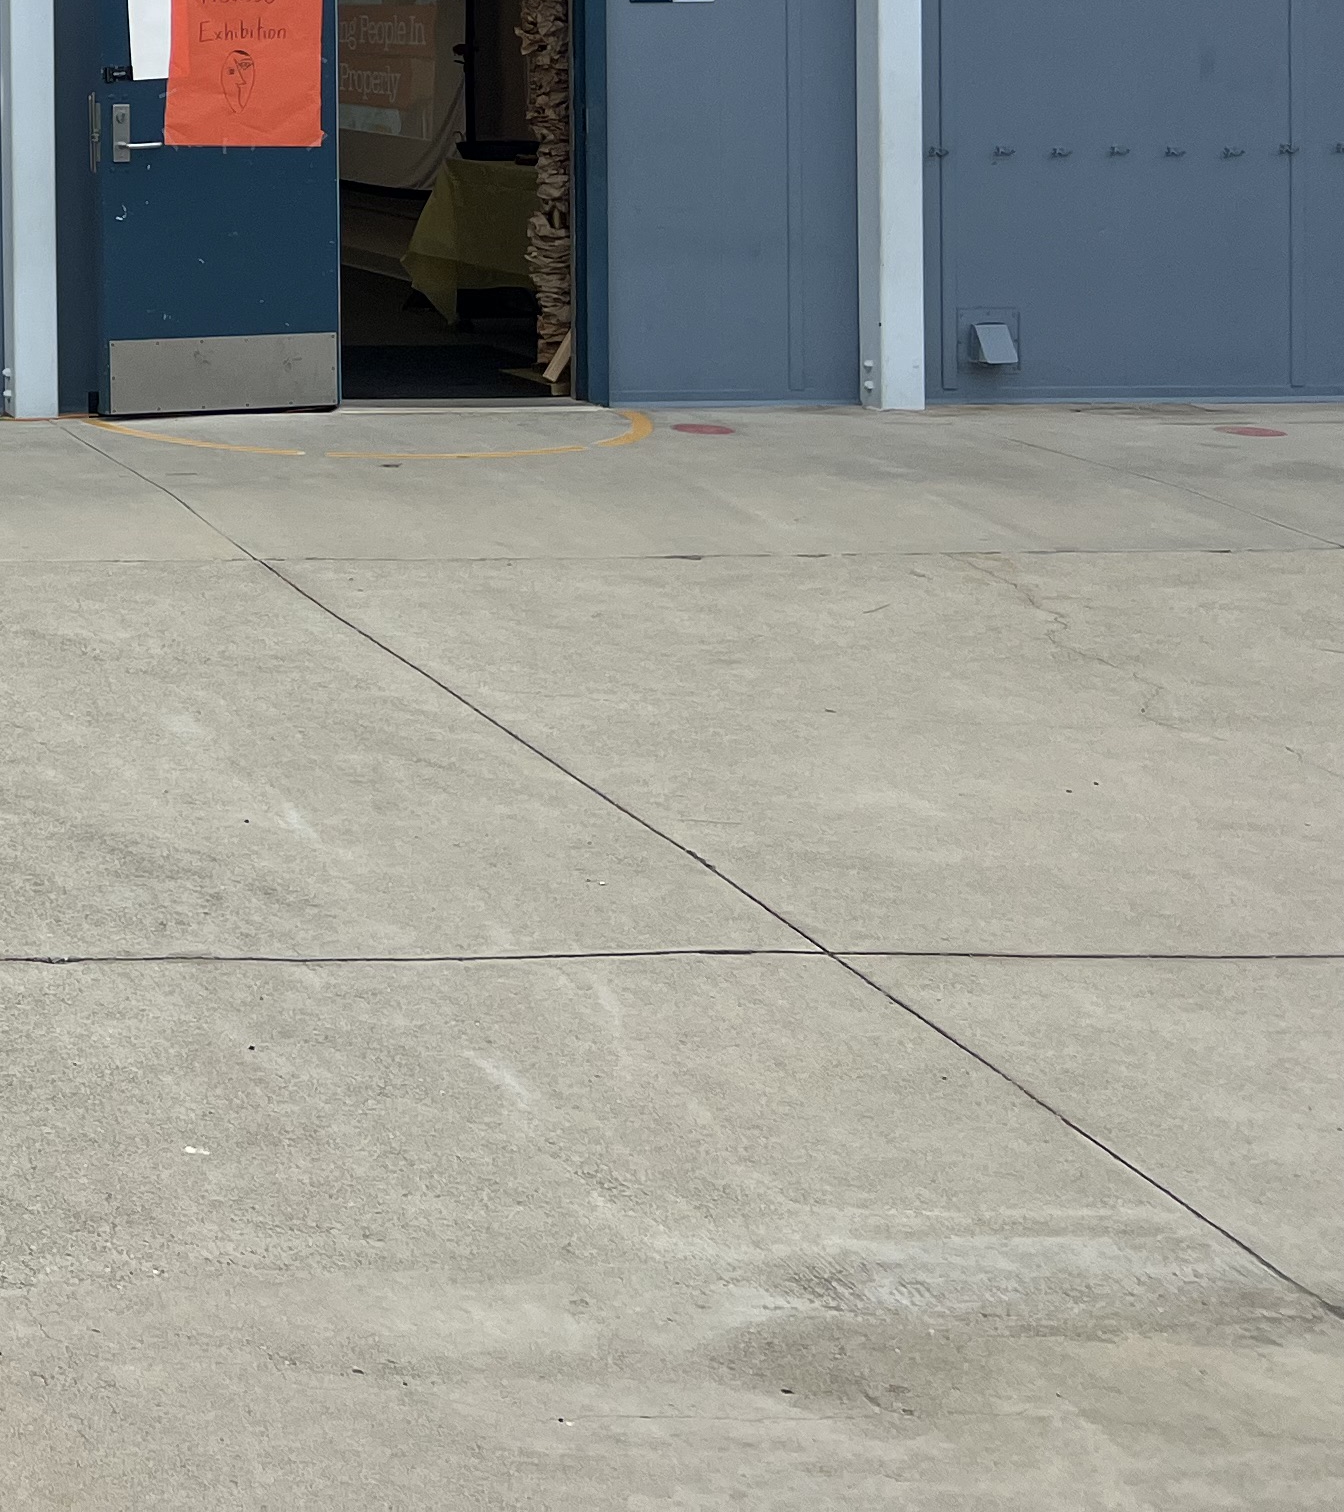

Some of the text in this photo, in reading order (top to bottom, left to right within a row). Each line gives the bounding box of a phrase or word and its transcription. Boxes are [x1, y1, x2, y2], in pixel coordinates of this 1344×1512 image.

[199, 16, 287, 43] Exhibition
[339, 14, 427, 52] ng People In
[339, 62, 402, 104] Properly
